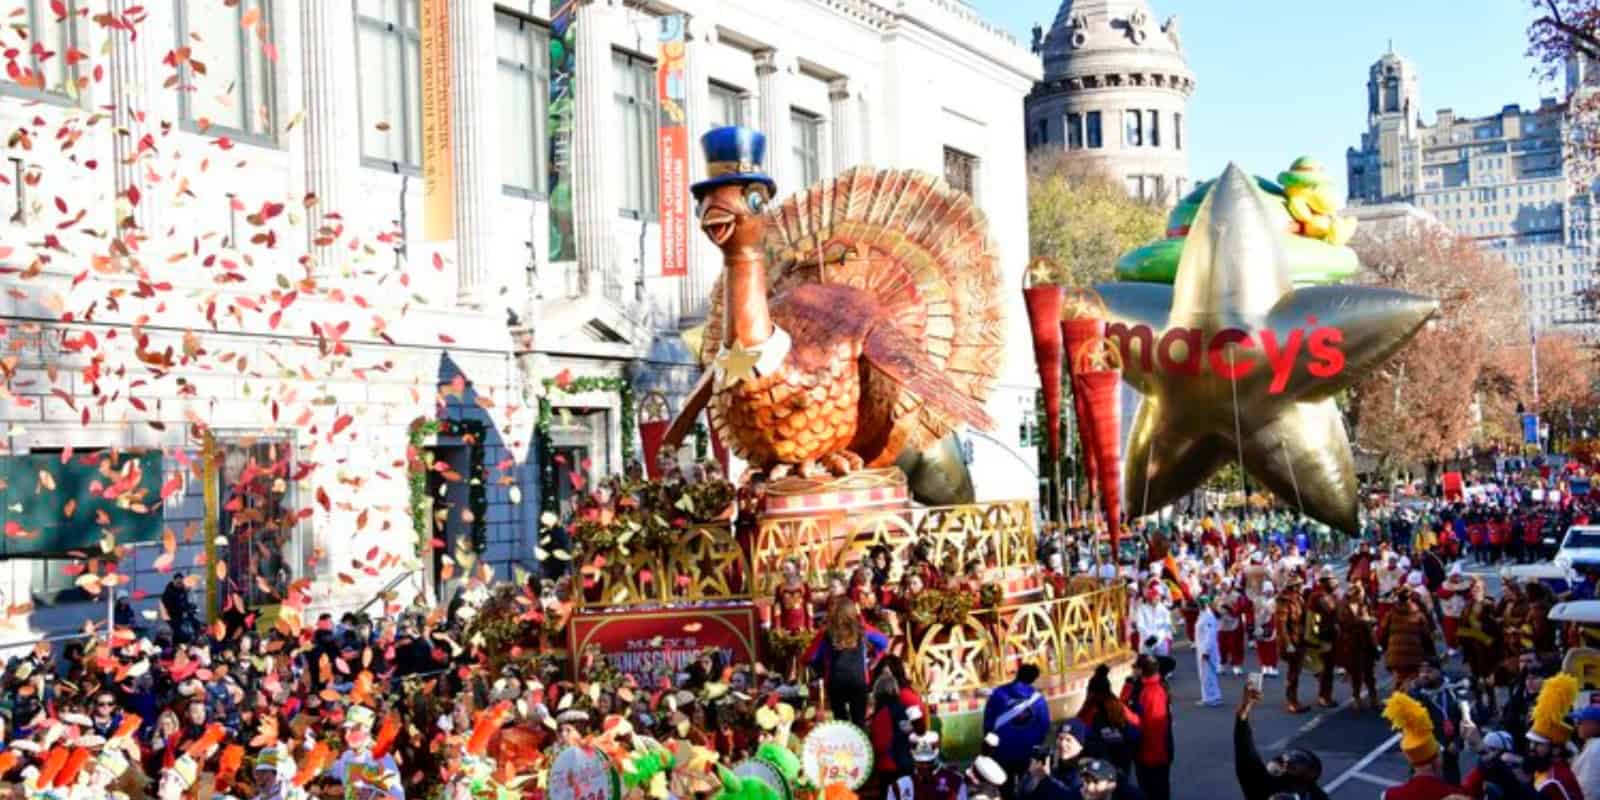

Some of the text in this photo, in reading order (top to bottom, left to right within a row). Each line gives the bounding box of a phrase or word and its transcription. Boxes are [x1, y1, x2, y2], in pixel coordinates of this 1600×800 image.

[423, 37, 434, 118] HISTORICAL
[424, 122, 434, 161] YORK
[674, 159, 685, 269] HISTORY MUSEUM
[1105, 314, 1345, 394] macy's
